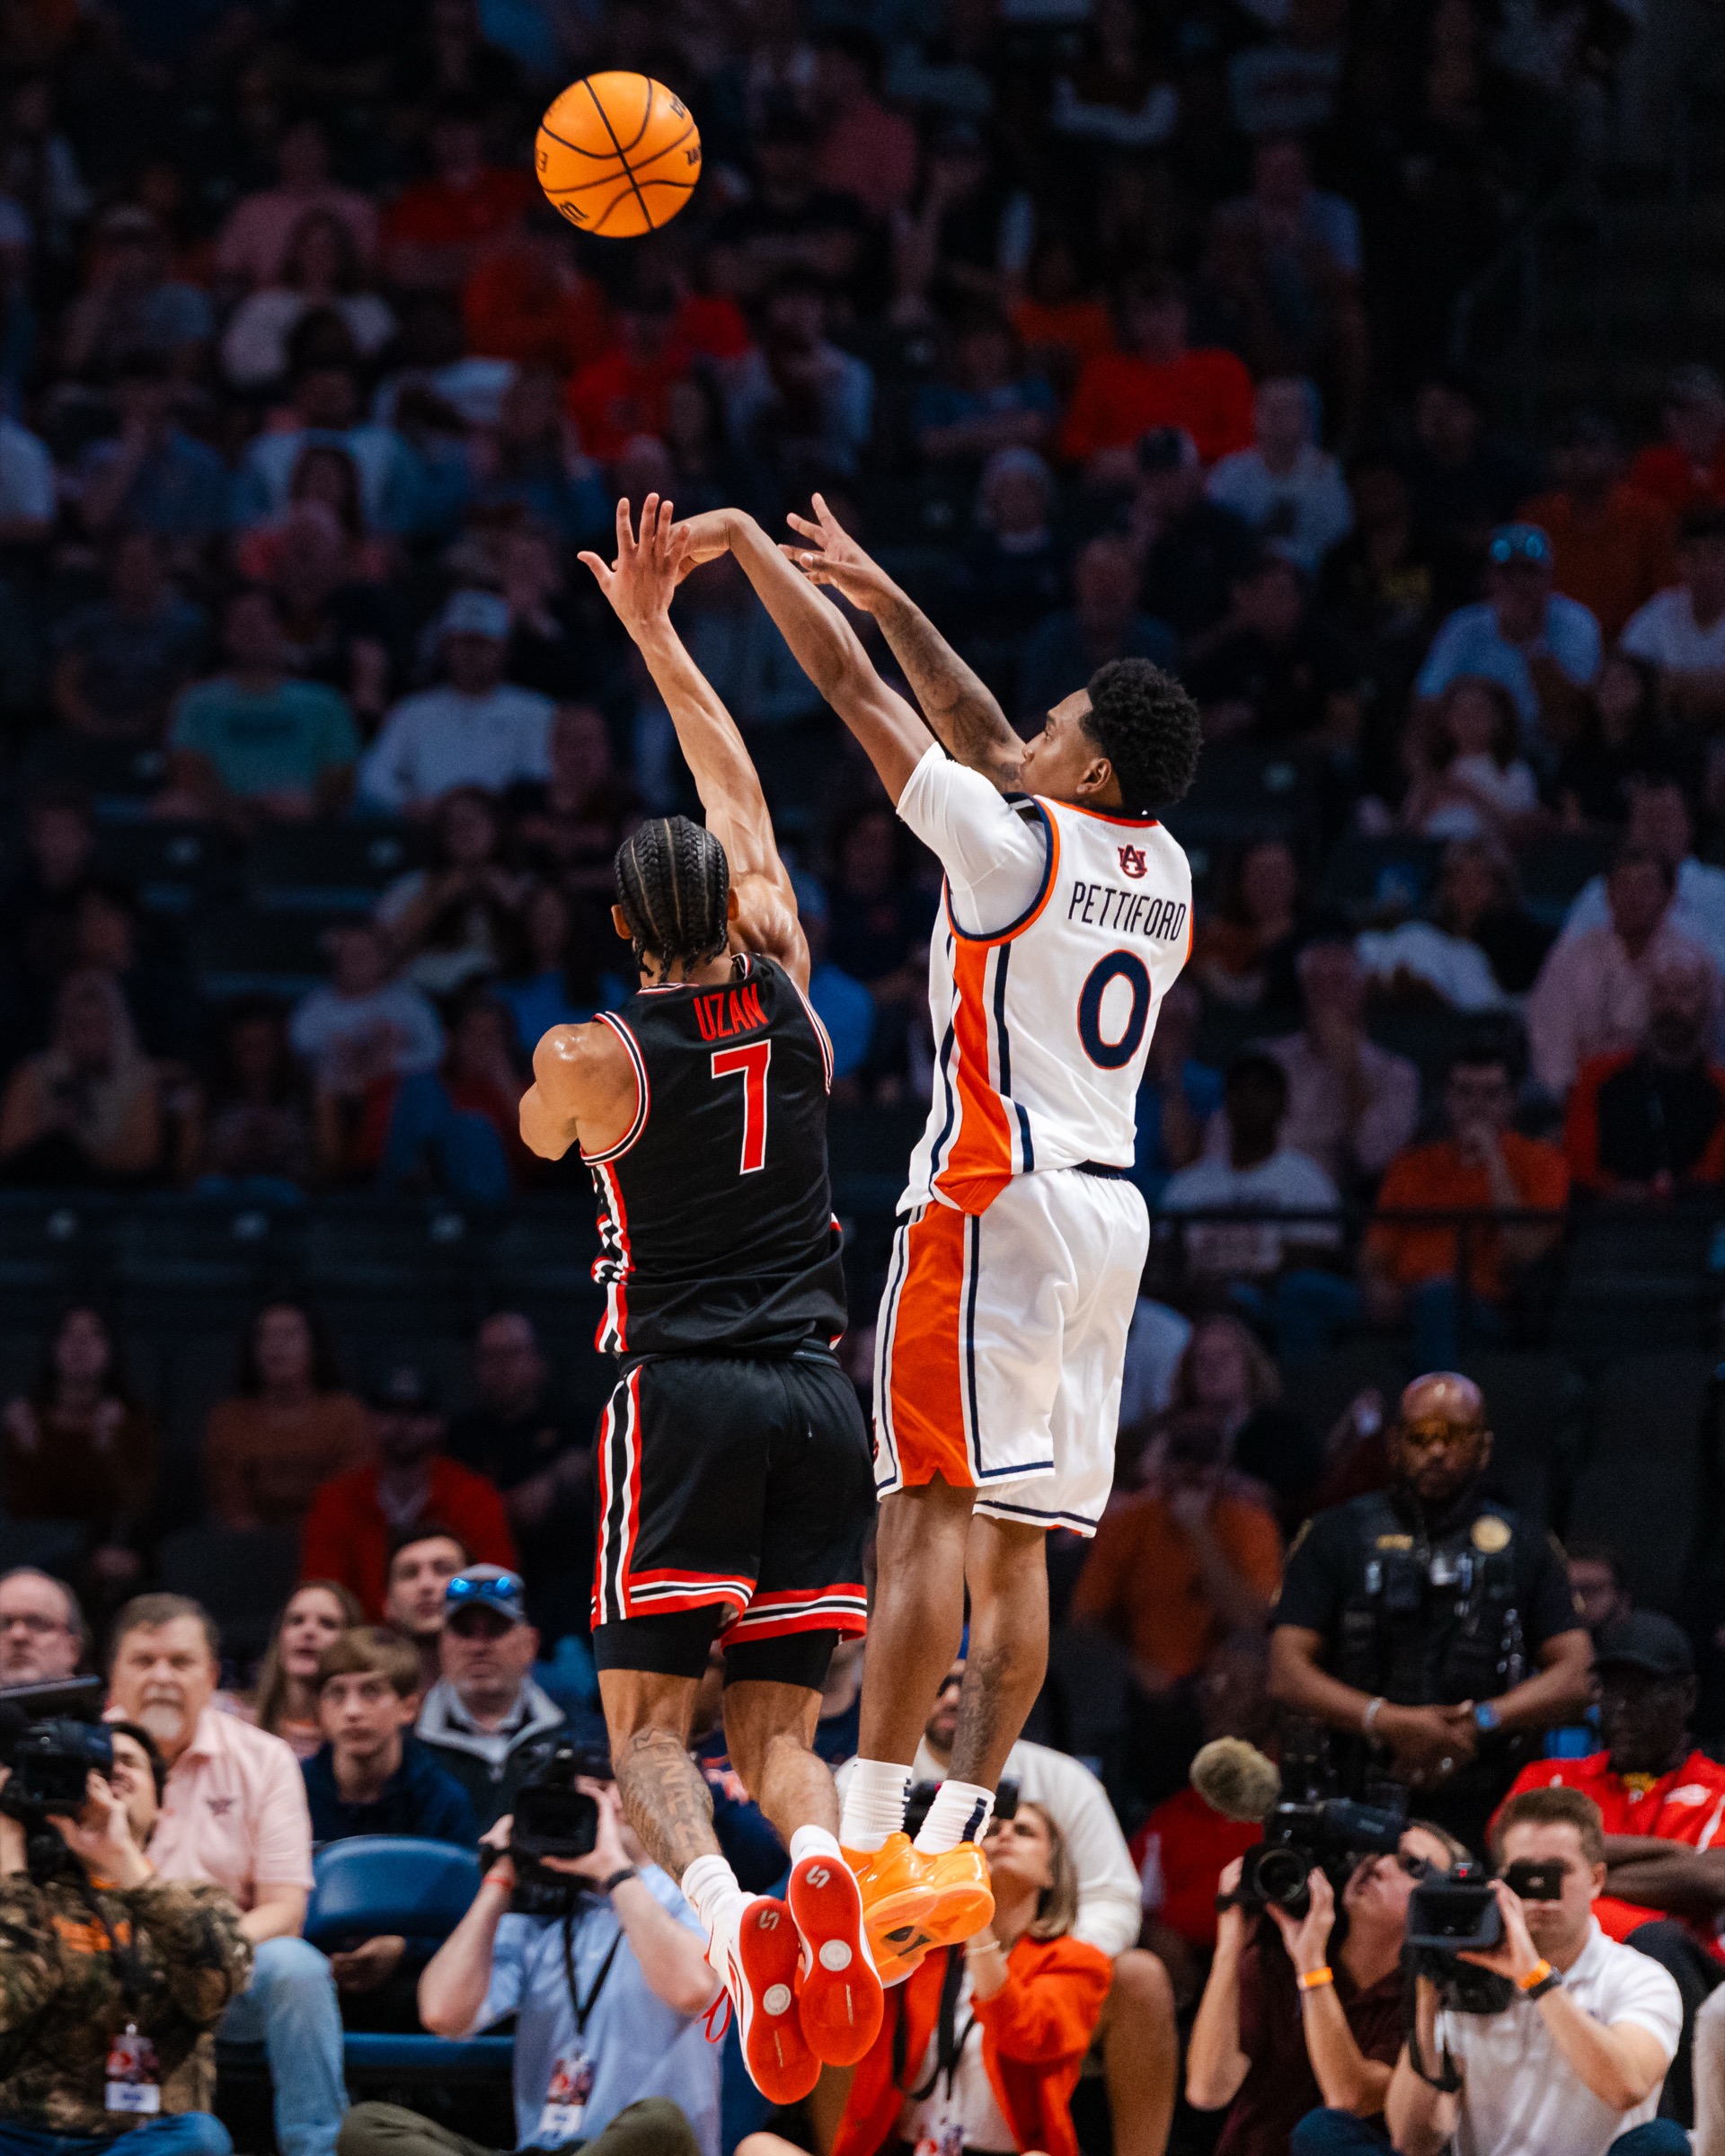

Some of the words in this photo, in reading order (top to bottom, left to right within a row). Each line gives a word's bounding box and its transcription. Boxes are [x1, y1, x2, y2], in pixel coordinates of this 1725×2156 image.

[1067, 881, 1187, 941] PETTIFORD
[694, 984, 768, 1041] UZAN
[1077, 949, 1151, 1070] 0
[711, 1038, 771, 1175] 7
